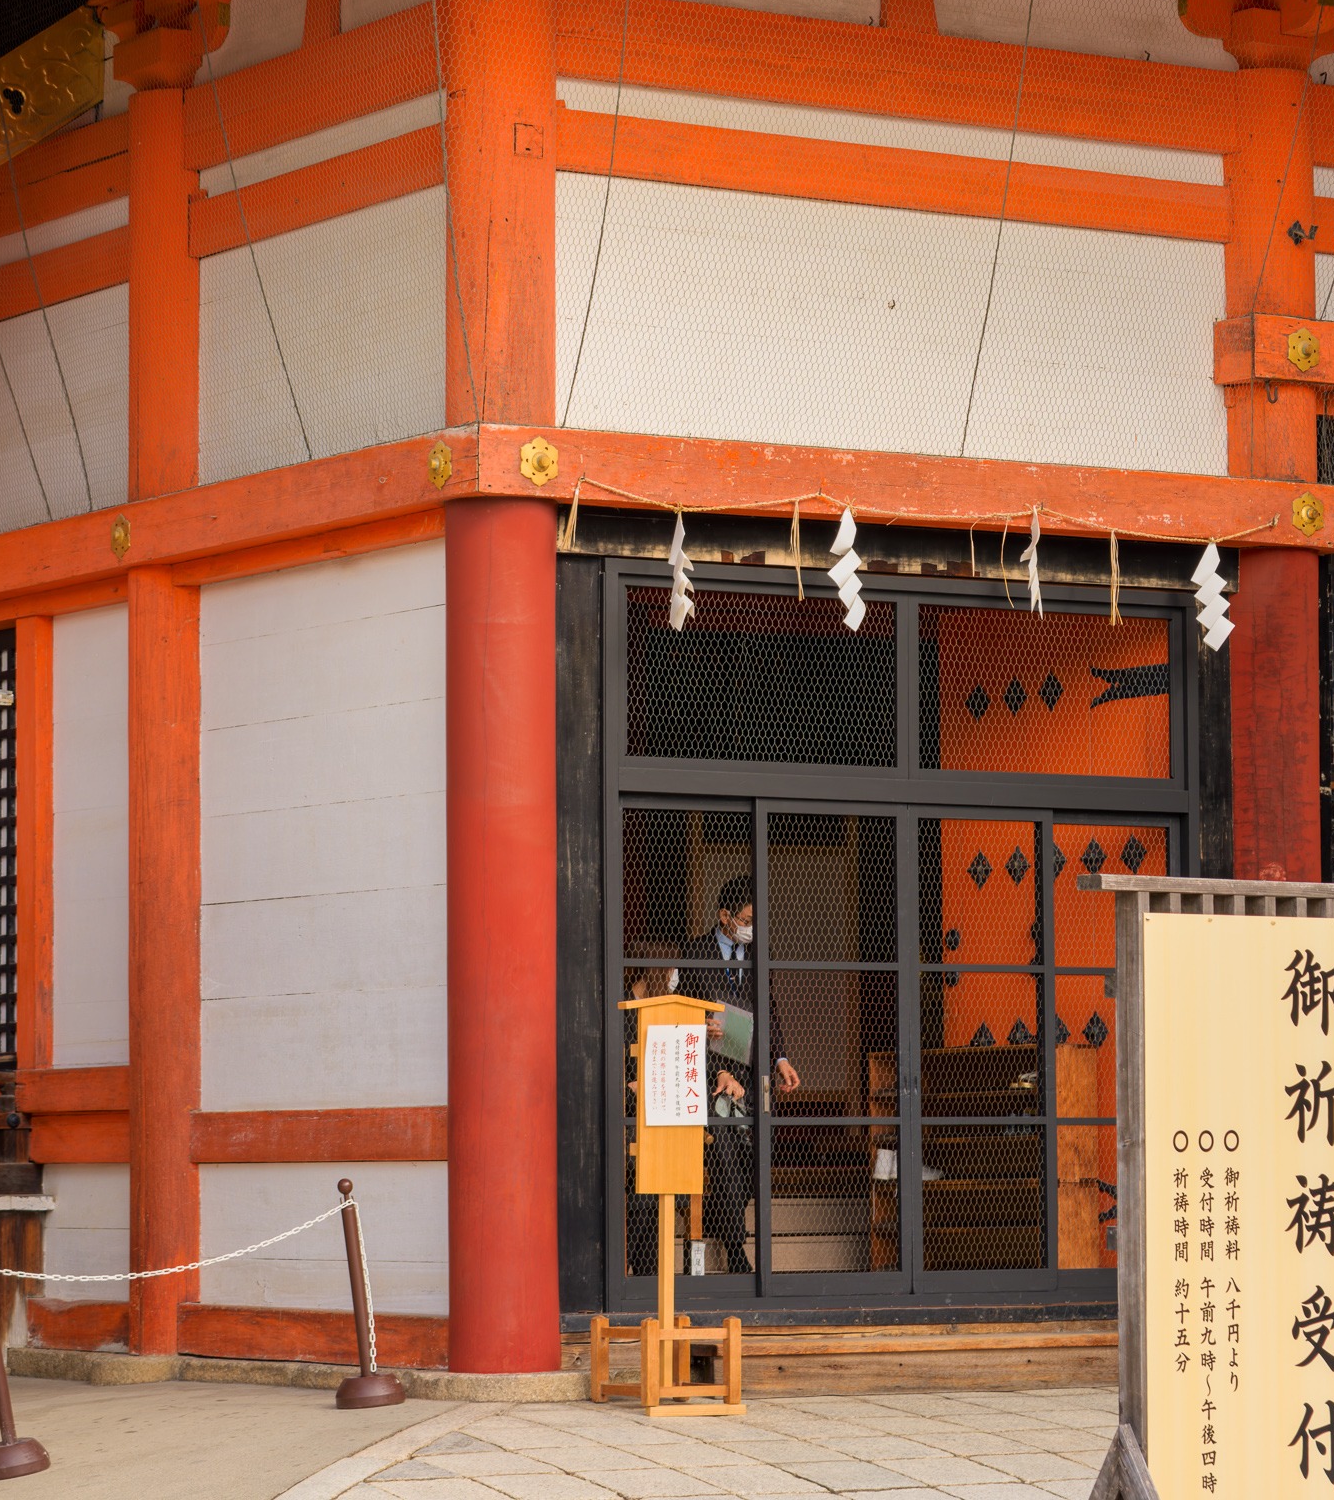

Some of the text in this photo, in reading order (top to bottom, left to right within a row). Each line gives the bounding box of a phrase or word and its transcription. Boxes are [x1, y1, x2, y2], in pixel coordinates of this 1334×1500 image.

[684, 1032, 700, 1114] 御祈祷入口
[1173, 1167, 1191, 1373] 祈祷時間 約十五分
[1199, 1166, 1215, 1262] 受付時間
[1223, 1166, 1242, 1392] 御祈祷料 八千円より
